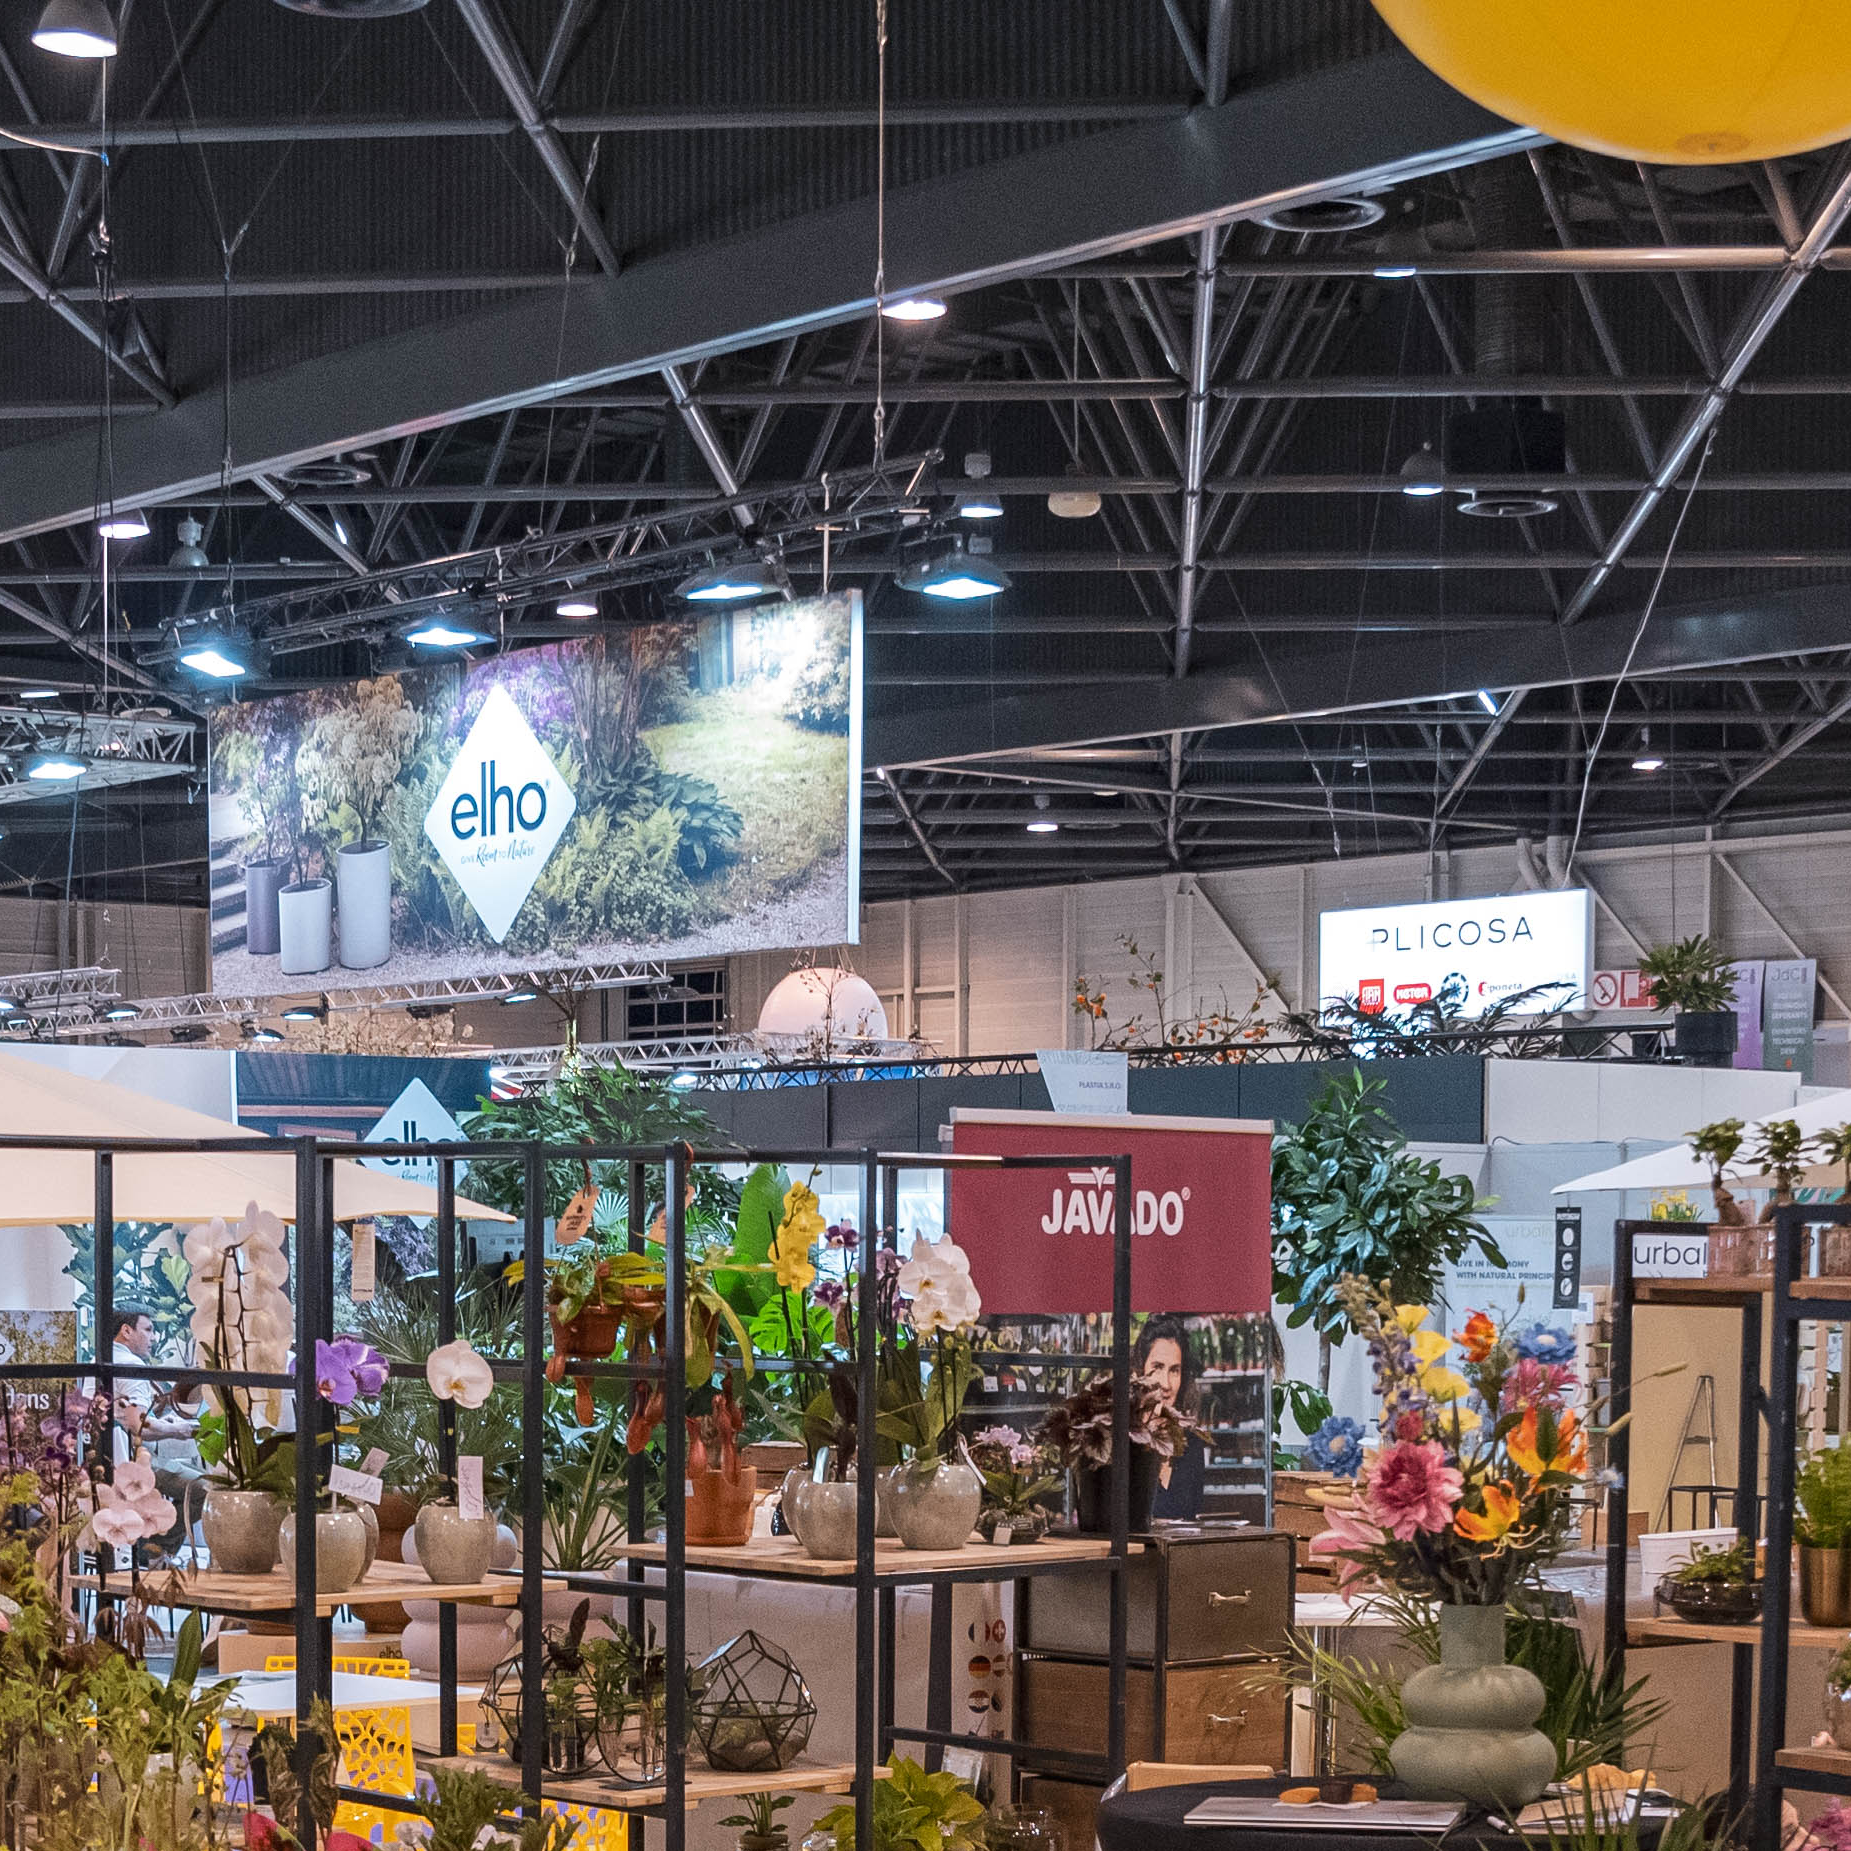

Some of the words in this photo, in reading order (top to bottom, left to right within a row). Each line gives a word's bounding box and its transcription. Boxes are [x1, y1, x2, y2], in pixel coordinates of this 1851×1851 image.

[451, 760, 547, 840] elho
[1368, 916, 1534, 951] PLICOSA
[1633, 1240, 1708, 1265] urbal
[1456, 1271, 1478, 1279] WITH
[1479, 1271, 1517, 1280] NATURAL
[379, 1645, 403, 1660] elho
